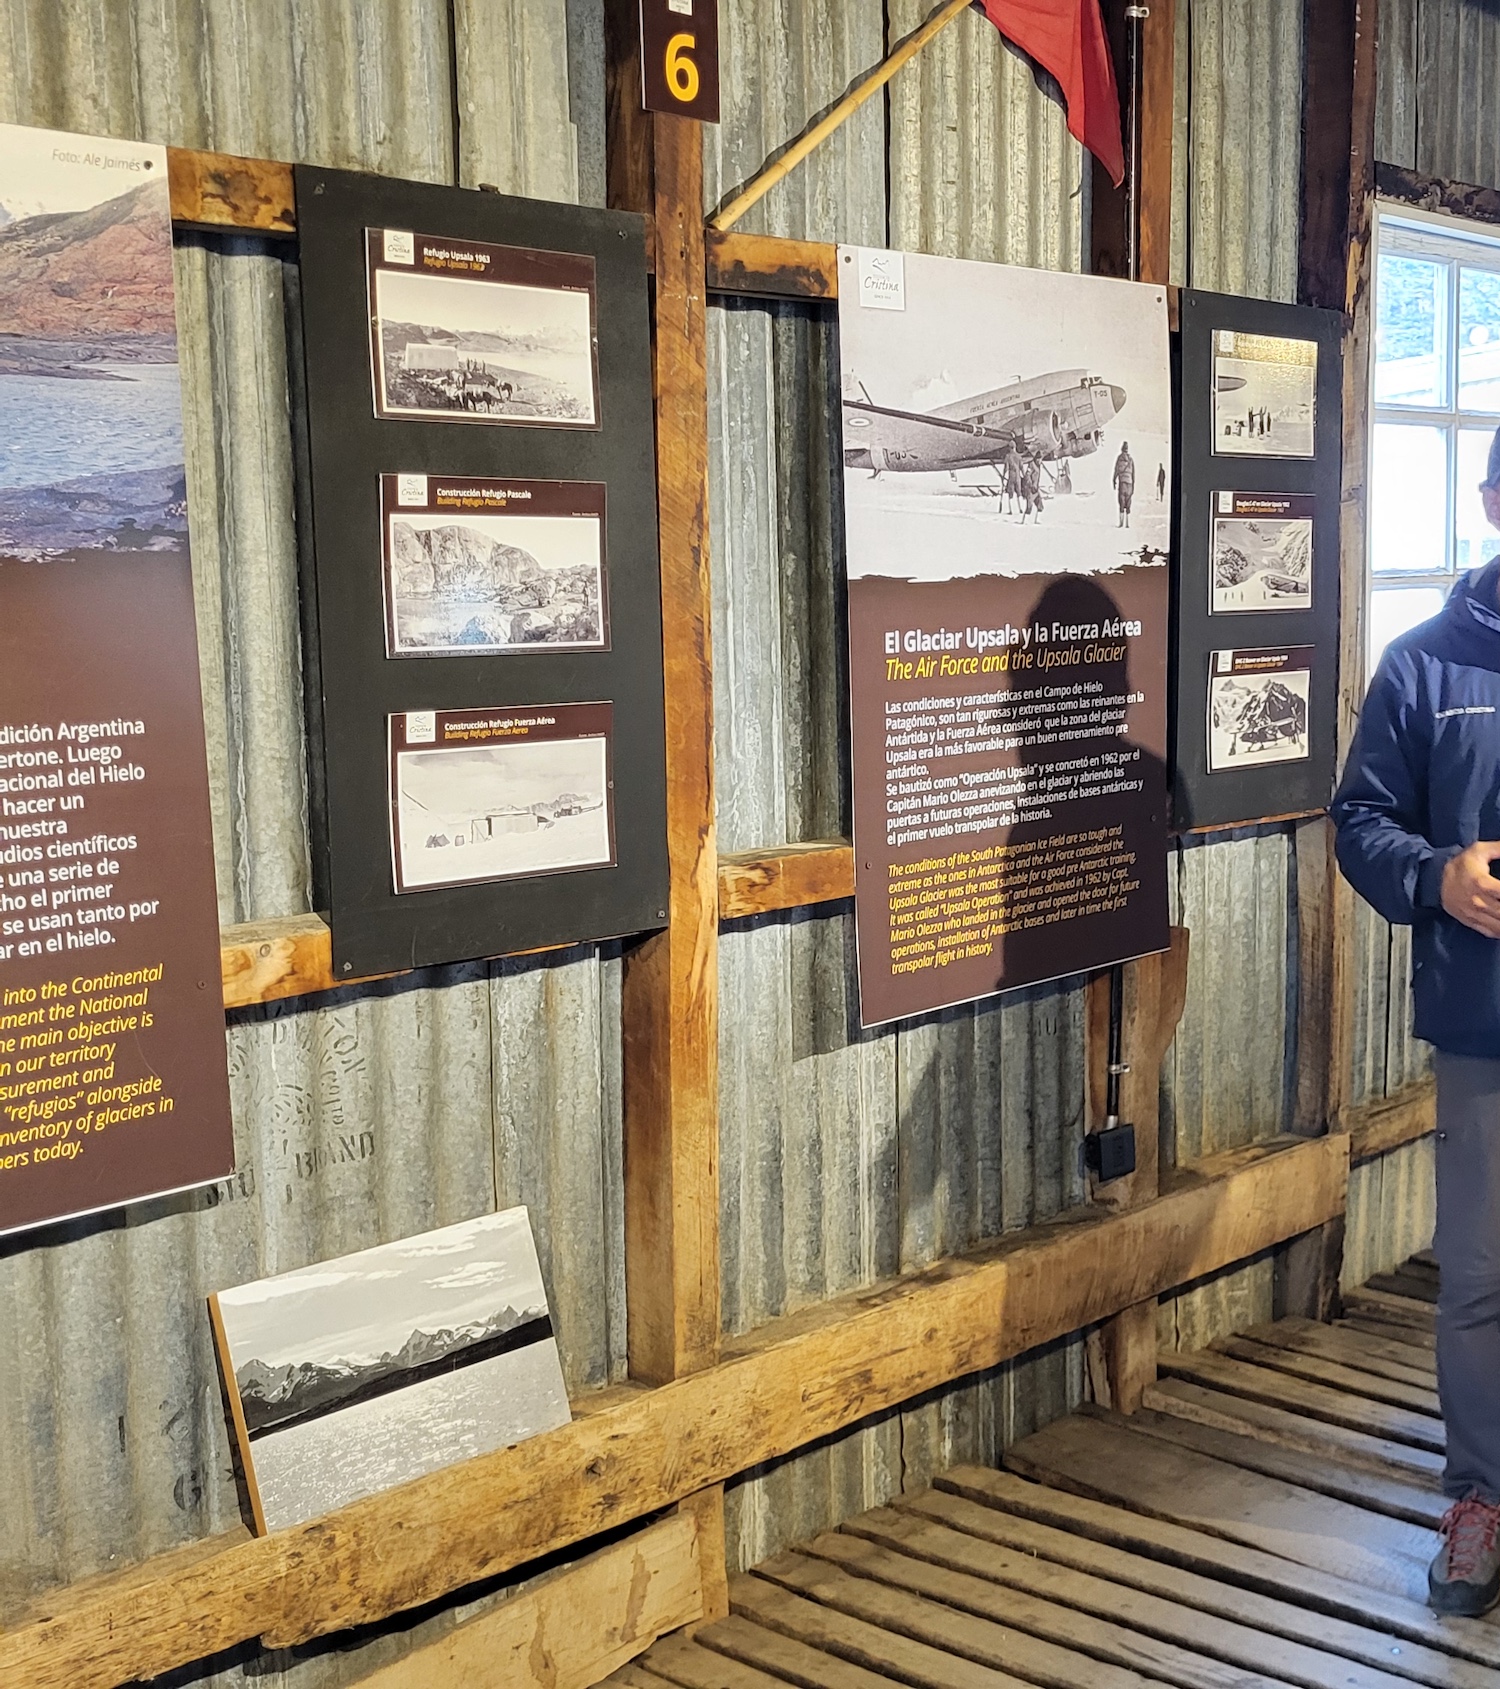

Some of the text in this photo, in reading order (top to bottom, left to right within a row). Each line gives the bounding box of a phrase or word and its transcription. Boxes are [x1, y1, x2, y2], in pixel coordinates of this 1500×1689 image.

[666, 34, 700, 102] 6
[52, 148, 140, 172] Foto: Ale Jaimés
[423, 247, 450, 260] Refugio
[450, 250, 474, 262] Upsala
[474, 254, 491, 264] 1963
[436, 488, 532, 500] Construcción Refugio Pascale
[885, 616, 1142, 654] El Glaciar Upsala y la Fuerza Aérea
[886, 643, 1126, 681] The Air Force and the Upsala Glacier
[886, 680, 1103, 714] Las condiciones y características en el Campo de Hielo
[886, 691, 1144, 732] Patagónico, son tan rigurosas y extremas como las reinantes en la
[58, 718, 146, 744] Argentina
[444, 716, 556, 731] Construcción Refugio Fuerza Aérea
[886, 708, 1126, 747] Antártida y la Fuerza Aérea consideró que la zona del glaciar
[67, 745, 122, 764] Luego
[0, 763, 146, 793] acional del Hielo
[886, 764, 930, 780] antártico.
[886, 784, 898, 796] Se
[899, 778, 932, 795] bautizó
[933, 776, 958, 790] como
[1039, 766, 1044, 777] y
[1045, 764, 1054, 774] se
[1055, 756, 1088, 772] concretó
[1090, 755, 1100, 766] en
[1100, 752, 1118, 764] 1962
[1119, 752, 1132, 766] por
[1132, 749, 1140, 760] el
[3, 794, 84, 816] hacer un
[47, 834, 138, 858] científicos
[8, 869, 44, 888] una
[49, 861, 93, 882] serie
[97, 858, 120, 876] de
[0, 883, 114, 912] ho el primer
[2, 900, 160, 936] se usan tanto por
[18, 940, 42, 956] en
[46, 932, 62, 952] el
[66, 928, 116, 950] hielo.
[892, 943, 993, 975] transpolar flight in history.
[4, 963, 164, 1006] into the Continental
[49, 1003, 76, 1022] the
[80, 988, 148, 1016] National
[20, 1028, 62, 1050] main
[68, 1014, 138, 1043] objective
[141, 1011, 154, 1027] is
[16, 1056, 46, 1074] our
[50, 1043, 116, 1067] territory
[82, 1062, 115, 1084] and
[87, 1076, 162, 1103] alongside
[76, 1113, 93, 1134] of
[95, 1100, 156, 1131] glaciers
[159, 1096, 174, 1114] in
[34, 1140, 84, 1164] today.
